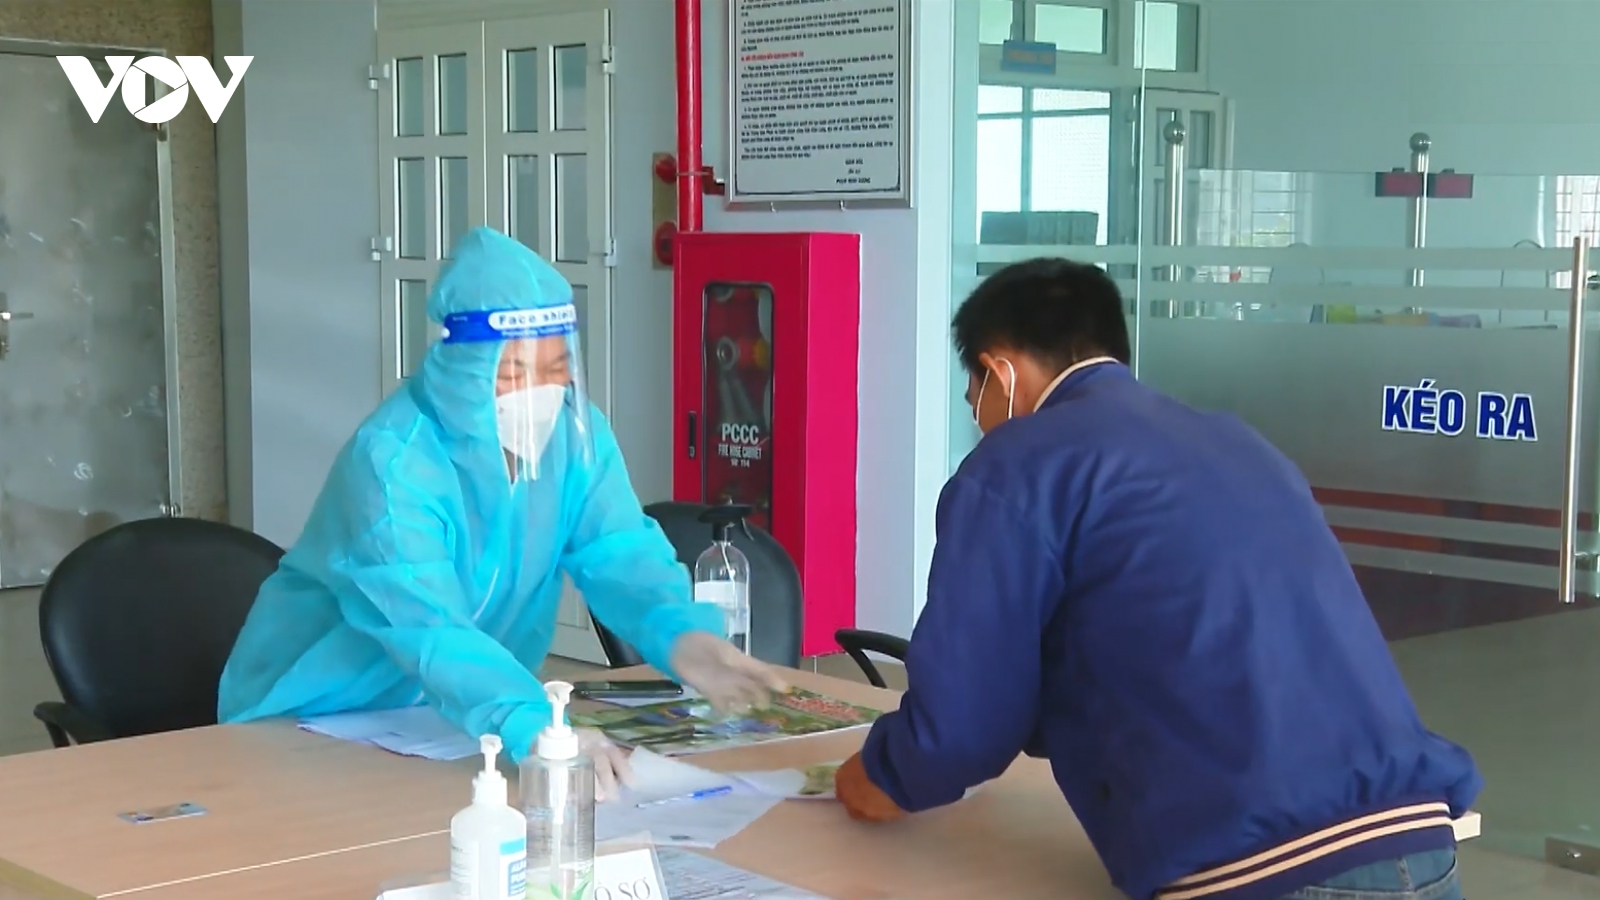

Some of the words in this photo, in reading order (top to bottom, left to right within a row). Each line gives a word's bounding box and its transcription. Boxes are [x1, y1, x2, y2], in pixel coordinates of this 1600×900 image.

[499, 313, 536, 326] Face
[543, 308, 575, 322] shiel
[1382, 379, 1466, 436] KÉO
[1476, 391, 1538, 441] RA
[722, 423, 759, 445] PCCC
